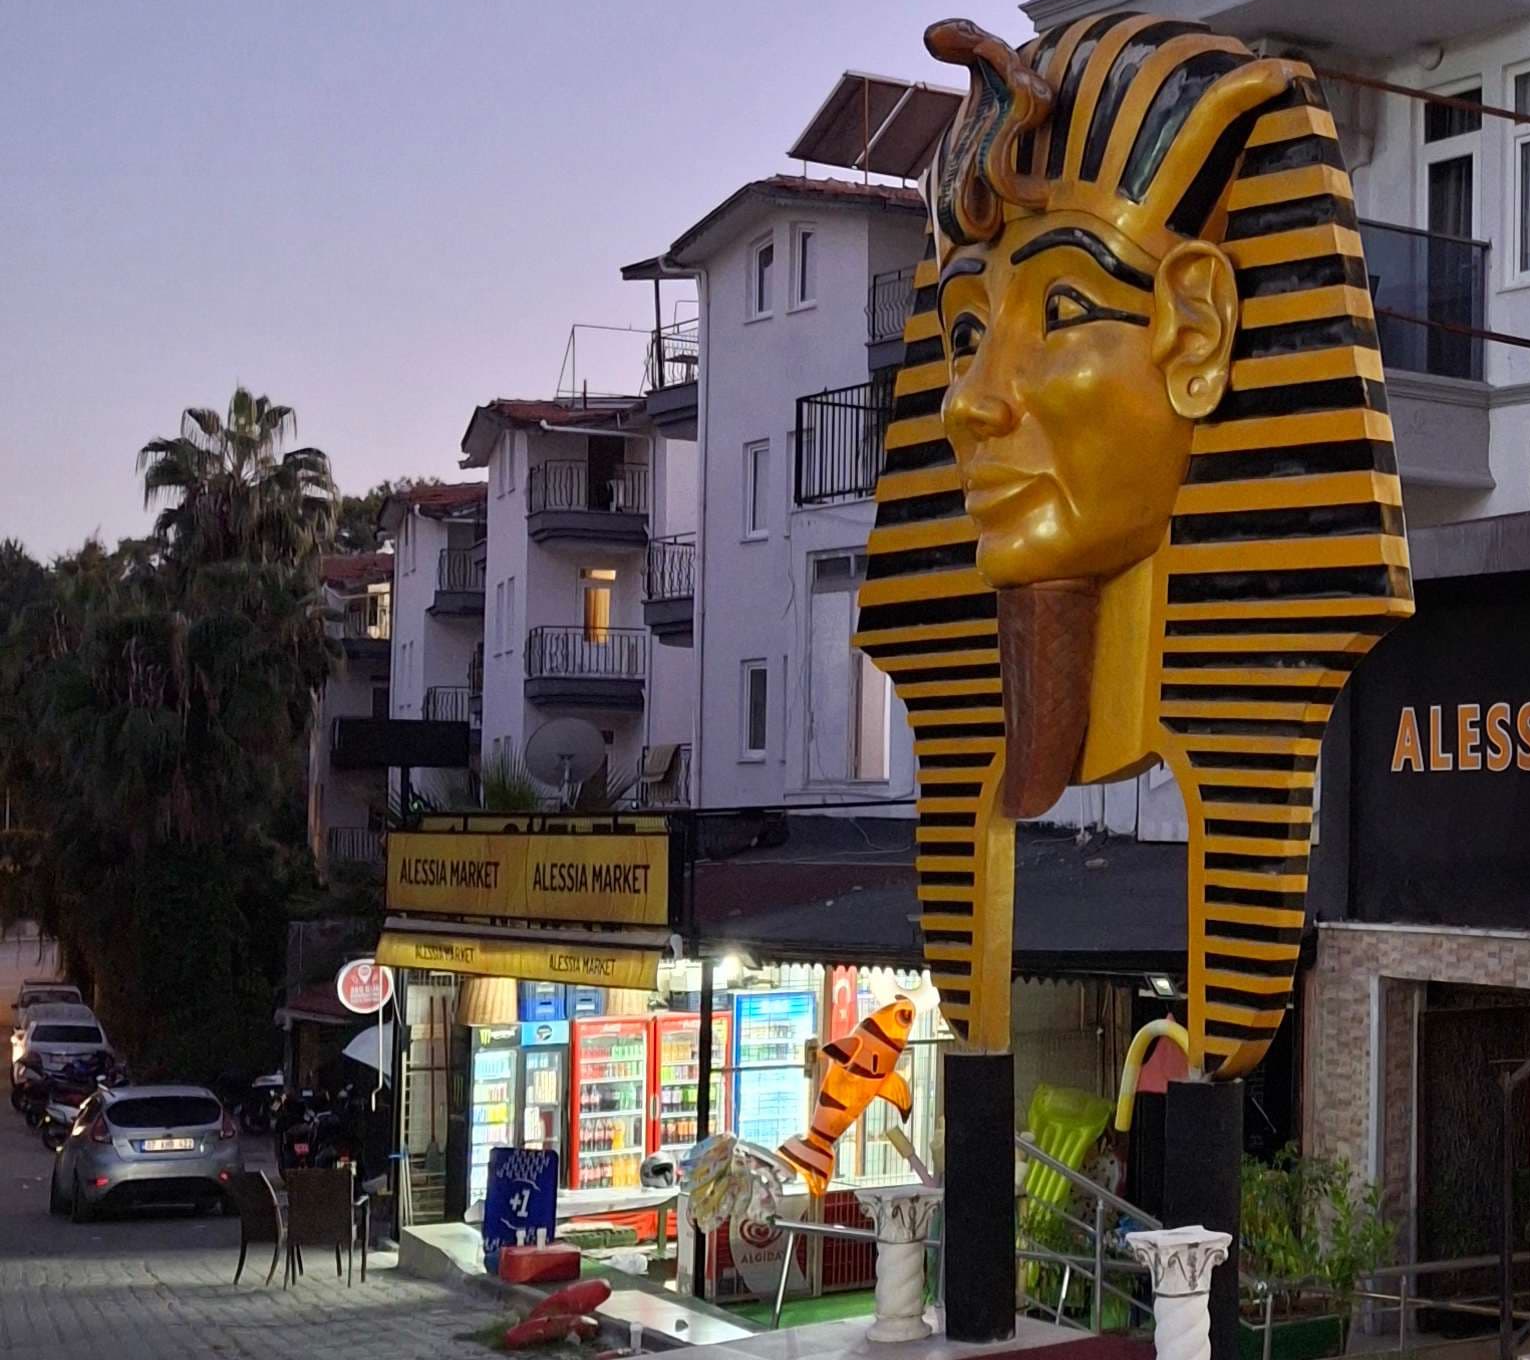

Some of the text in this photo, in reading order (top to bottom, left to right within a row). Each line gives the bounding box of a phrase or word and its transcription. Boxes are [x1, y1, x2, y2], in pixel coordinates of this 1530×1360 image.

[400, 858, 500, 889] ALESSIA MARKET
[533, 862, 650, 895] ALESSIA MARKET
[550, 954, 617, 976] ALESSIA MARKET
